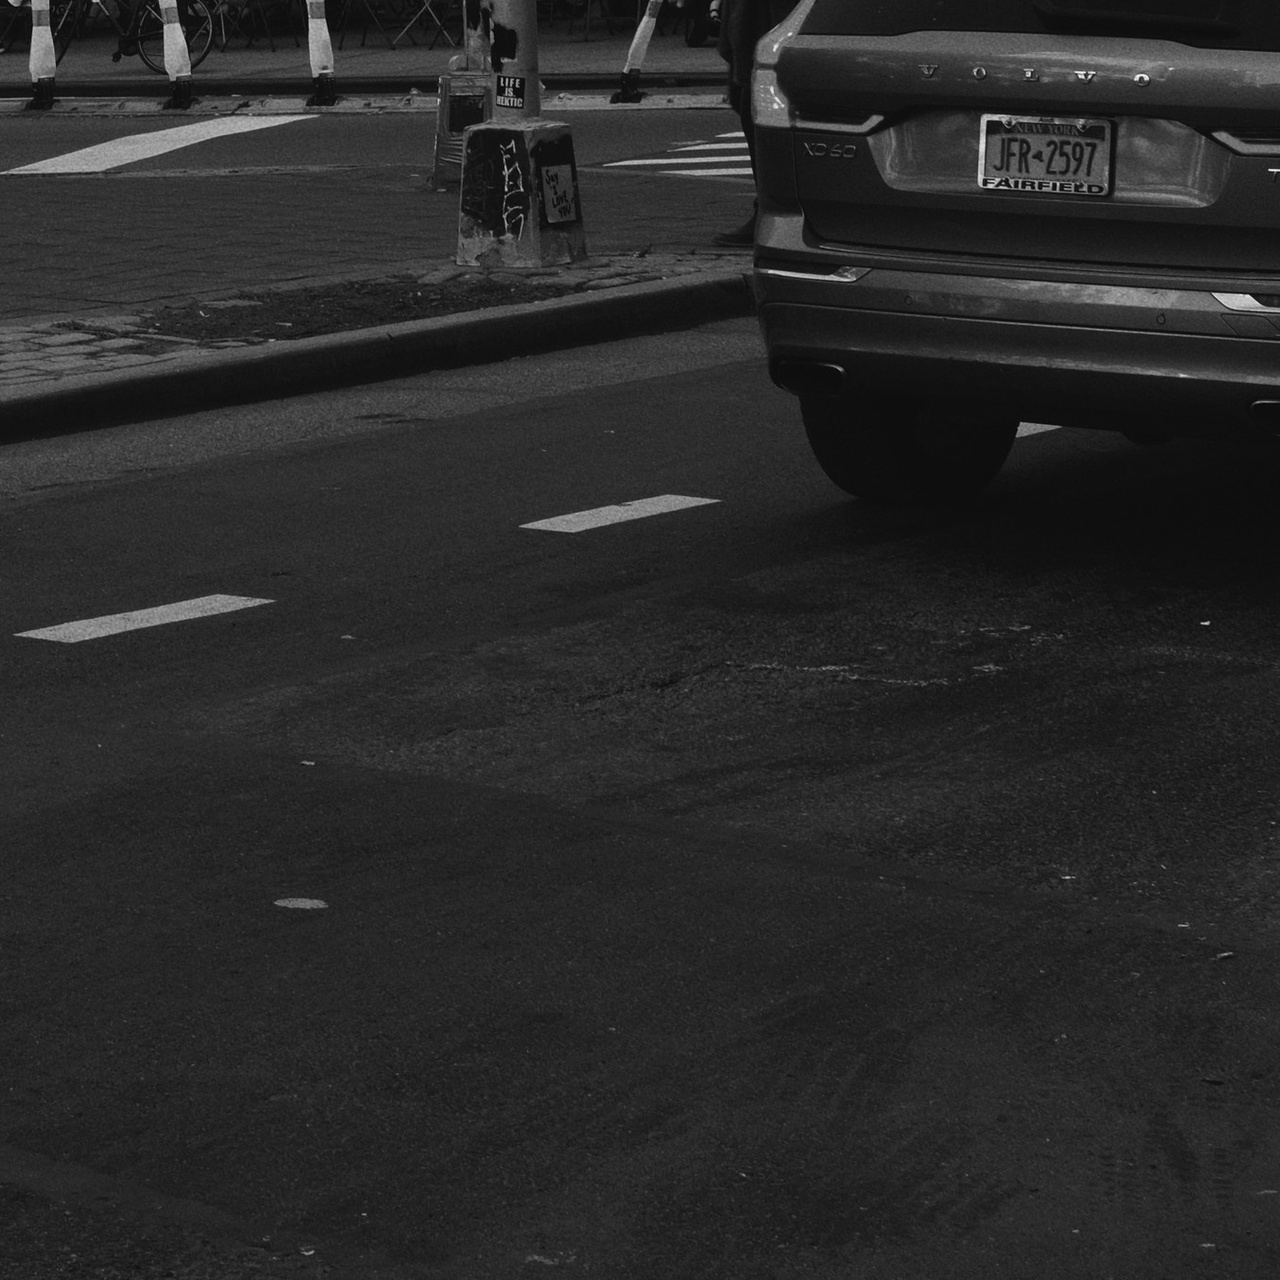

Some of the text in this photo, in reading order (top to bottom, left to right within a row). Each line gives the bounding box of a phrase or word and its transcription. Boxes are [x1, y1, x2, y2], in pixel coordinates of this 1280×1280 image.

[500, 76, 521, 89] LIFE
[918, 64, 1151, 87] VOLVO
[1014, 122, 1080, 136] NEW YORK
[982, 177, 1105, 194] FAIRFIELD
